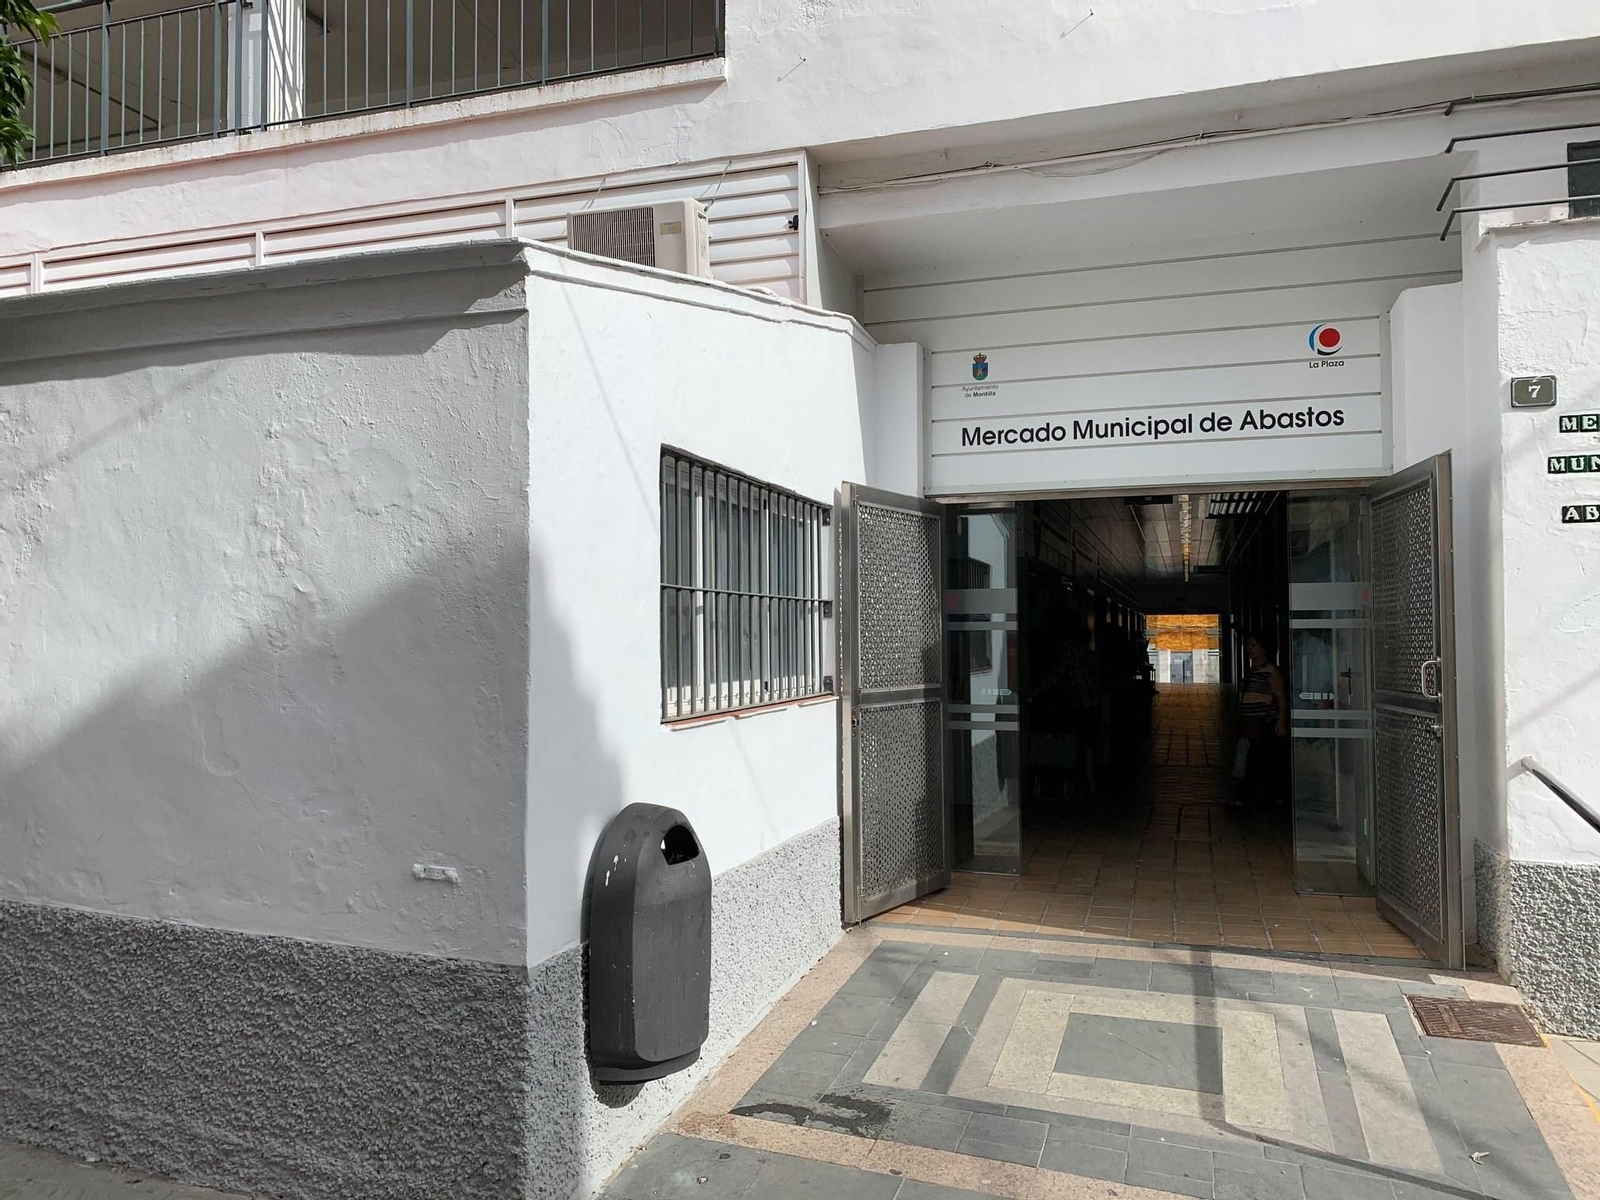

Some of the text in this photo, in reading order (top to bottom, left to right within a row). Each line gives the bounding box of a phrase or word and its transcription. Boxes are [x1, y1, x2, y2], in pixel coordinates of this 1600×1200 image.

[1309, 360, 1345, 369] La Plaza
[1528, 385, 1541, 398] 7
[961, 406, 1345, 447] Mercado Municipal de Abastos
